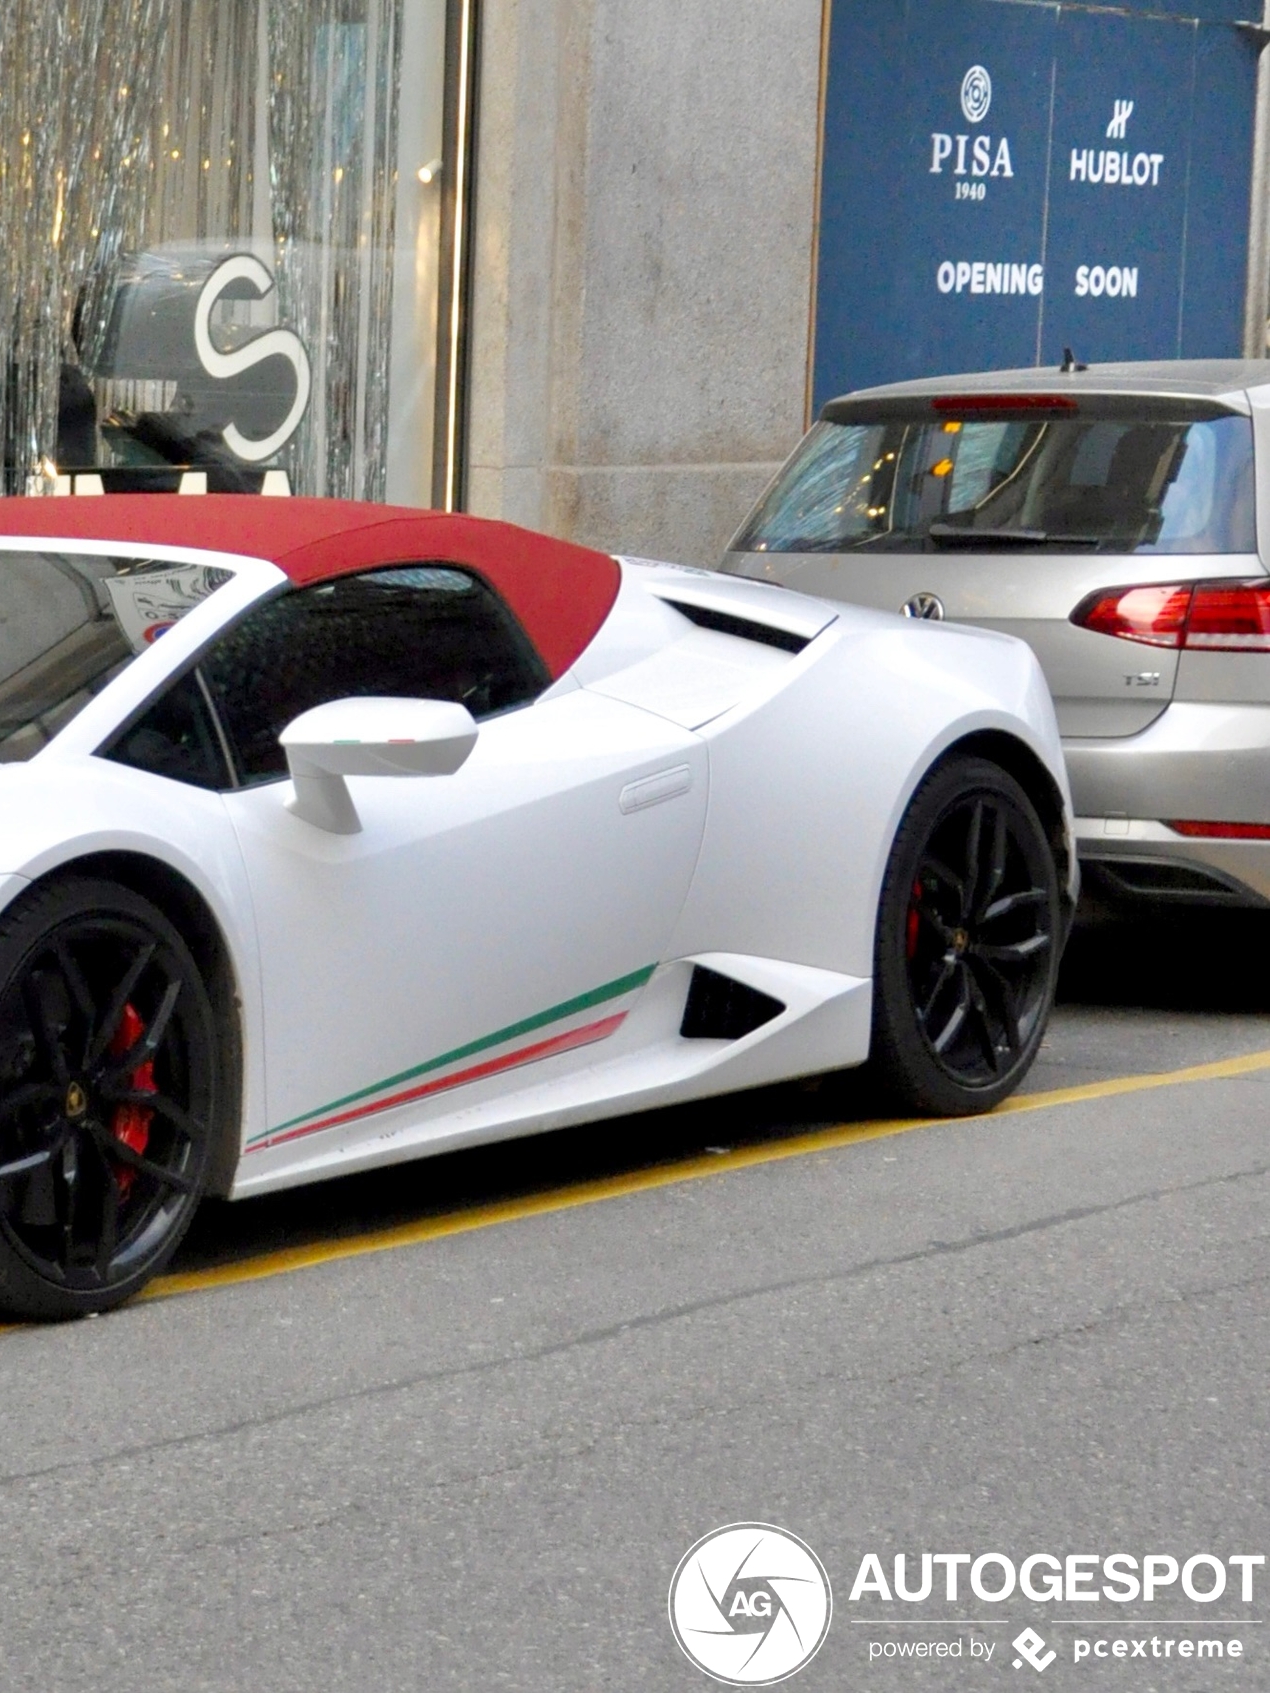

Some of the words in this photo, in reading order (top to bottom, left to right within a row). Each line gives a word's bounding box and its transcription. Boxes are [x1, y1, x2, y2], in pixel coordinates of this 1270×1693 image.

[930, 132, 1014, 177] PISA
[1069, 149, 1164, 186] HUBLOT
[955, 181, 986, 201] 1940
[937, 261, 1044, 296] OPENING
[1075, 265, 1138, 297] SOON
